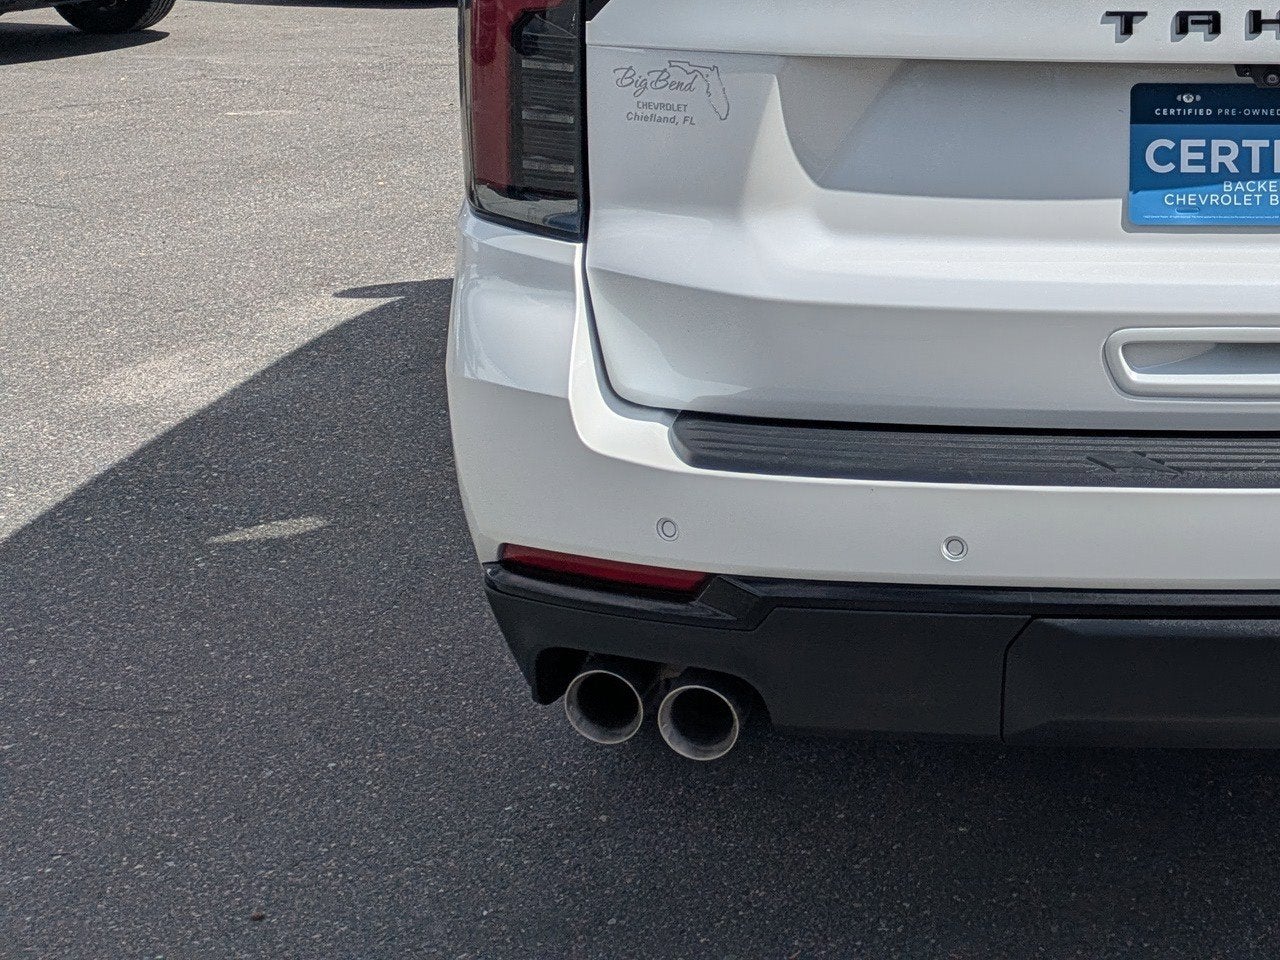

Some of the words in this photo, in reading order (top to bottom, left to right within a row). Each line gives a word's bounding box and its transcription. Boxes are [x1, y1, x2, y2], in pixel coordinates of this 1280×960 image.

[613, 65, 649, 98] Big
[647, 67, 698, 93] Bend
[636, 100, 689, 112] CHEVROLET
[1154, 108, 1213, 116] CERTIFIED
[683, 115, 696, 126] FL
[1163, 193, 1262, 207] CHEVROLET
